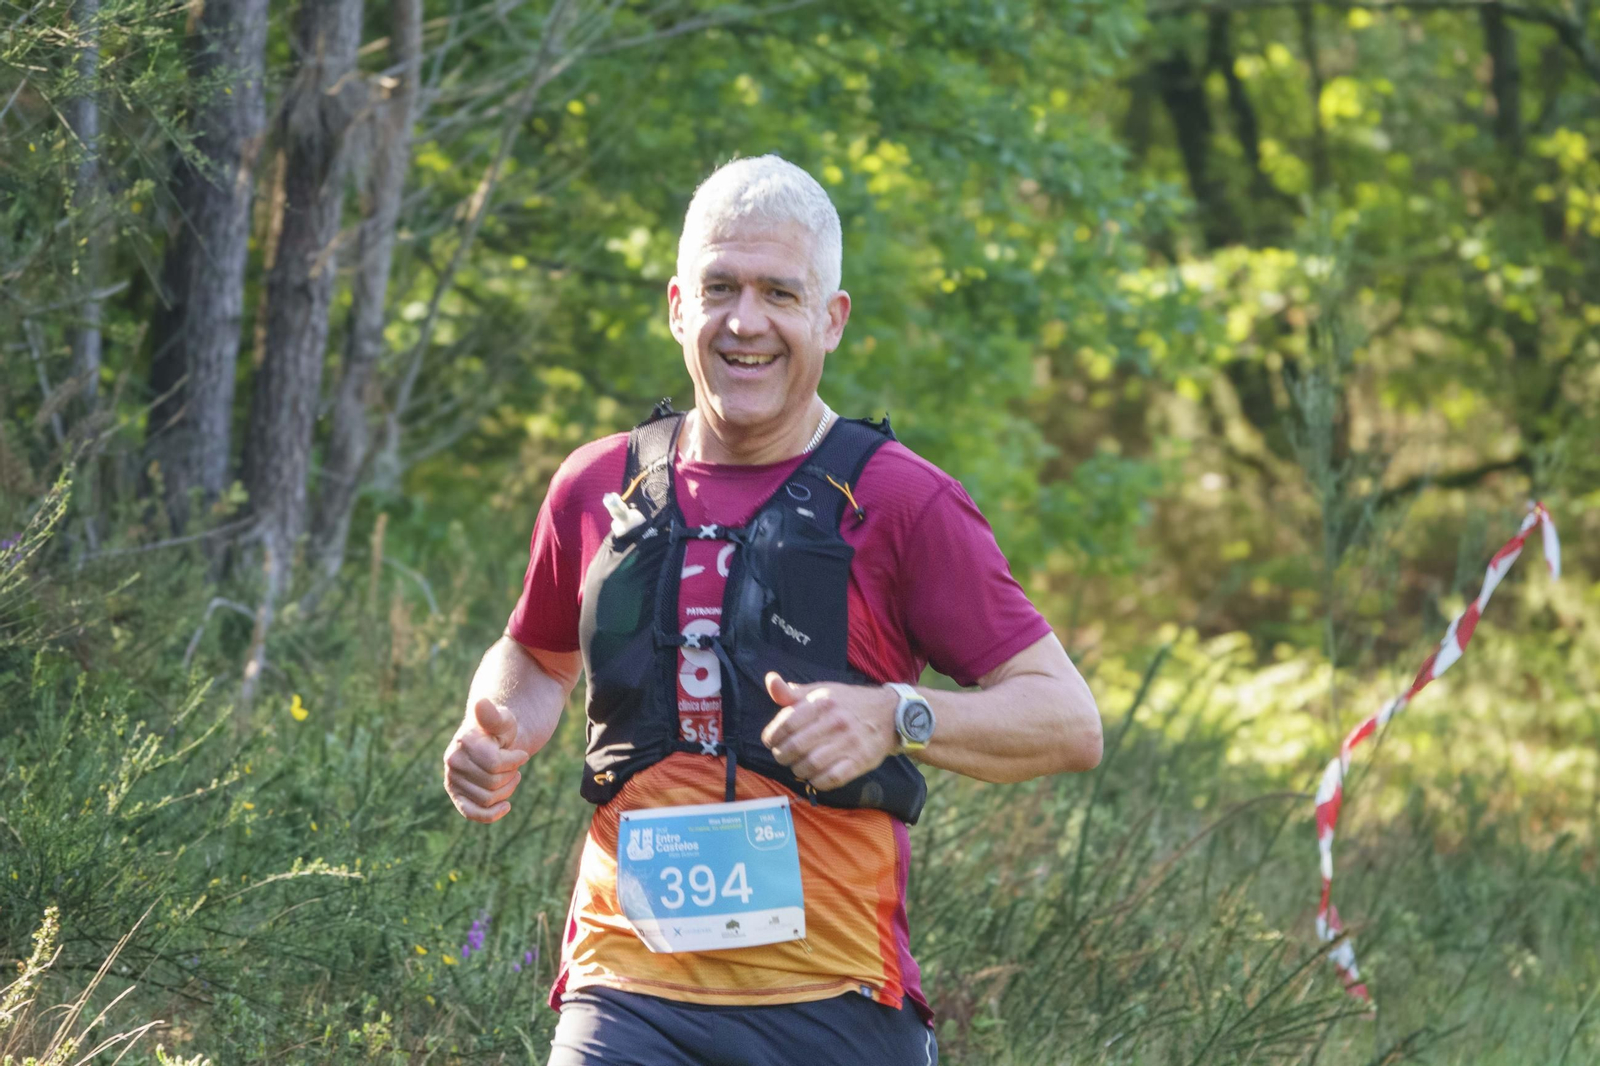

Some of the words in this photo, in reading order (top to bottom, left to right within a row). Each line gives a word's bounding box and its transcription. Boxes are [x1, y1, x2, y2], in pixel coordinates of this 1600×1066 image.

[656, 834, 681, 844] Entre
[656, 842, 699, 852] Castelos
[659, 862, 753, 910] 394
